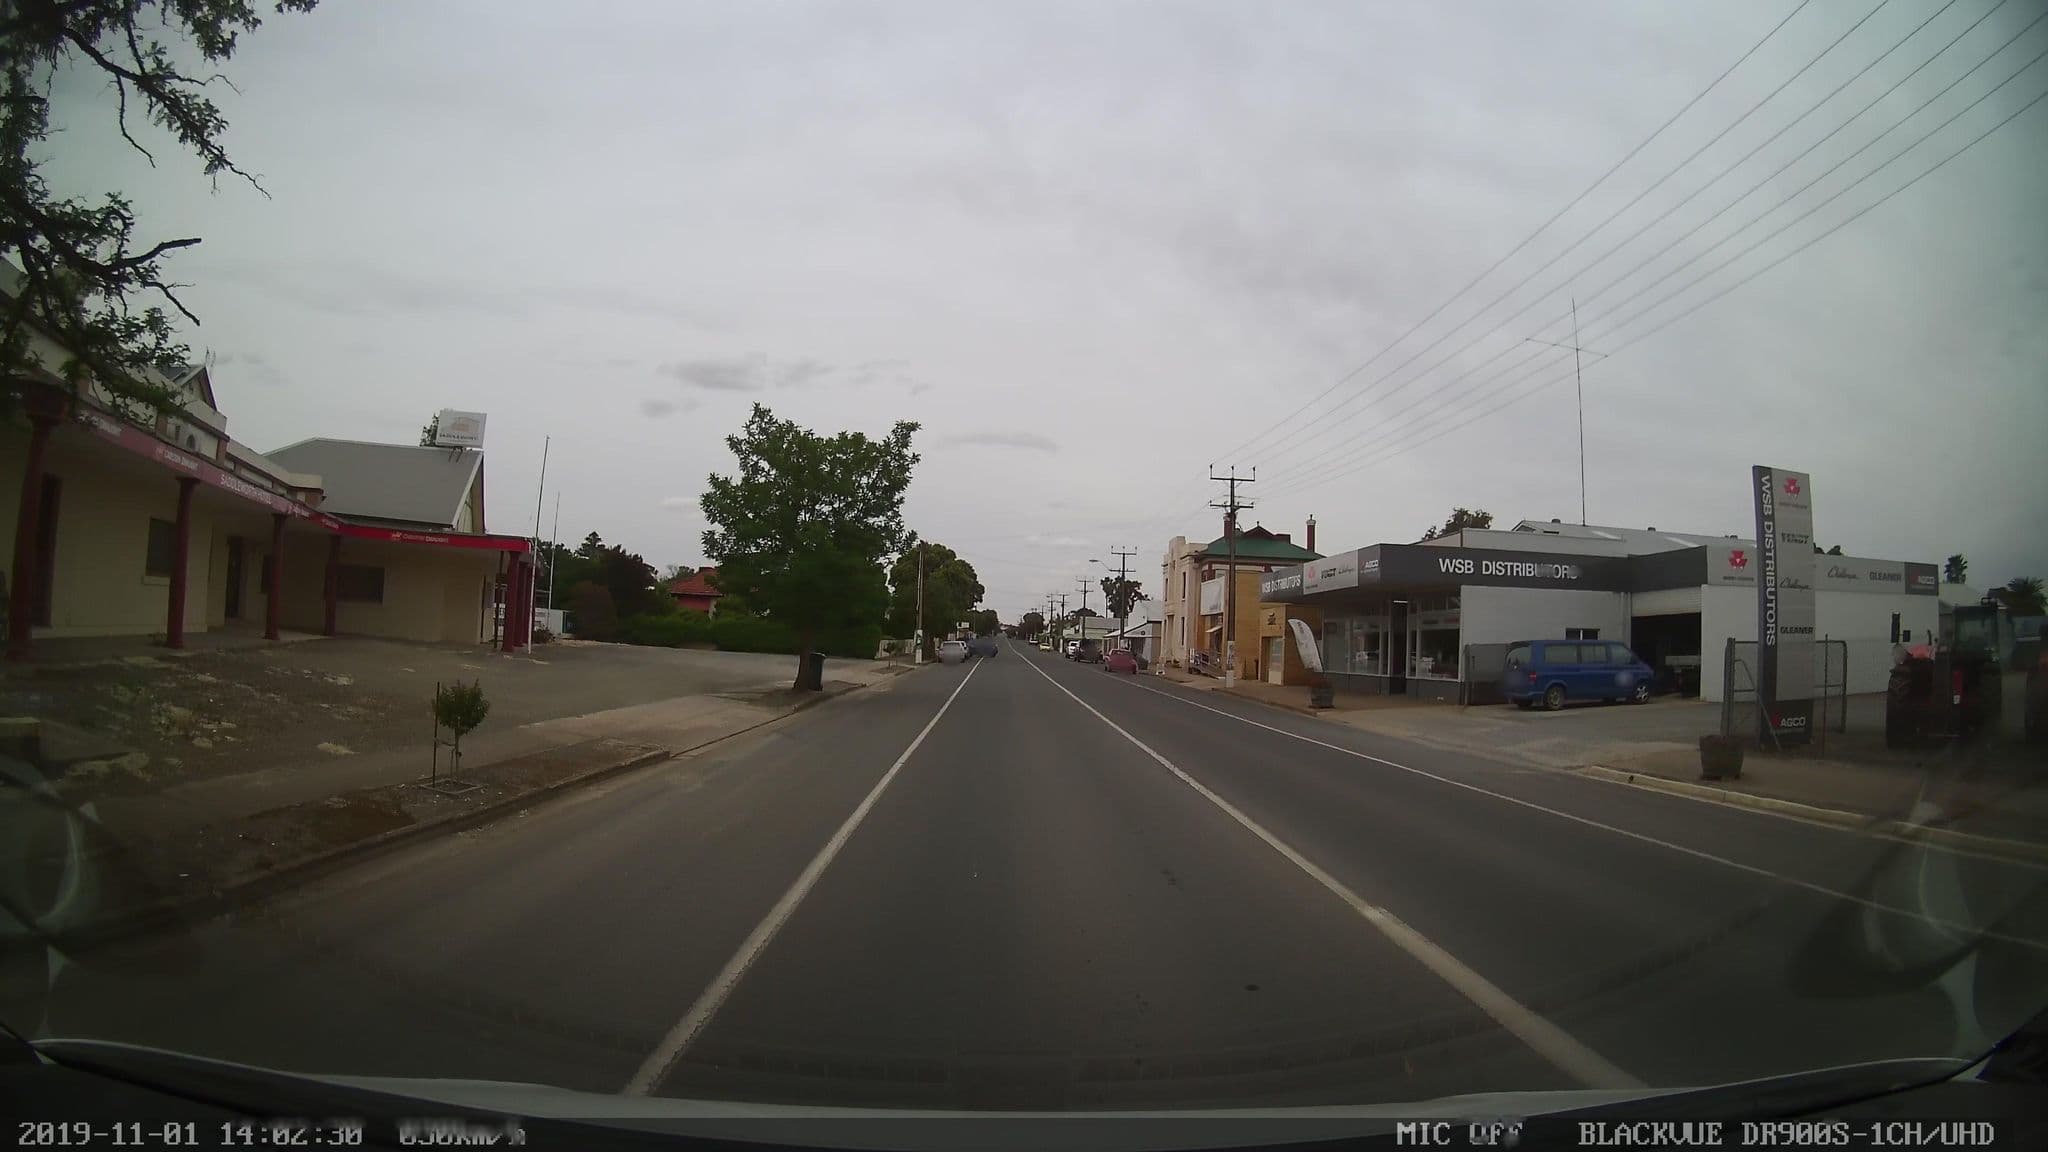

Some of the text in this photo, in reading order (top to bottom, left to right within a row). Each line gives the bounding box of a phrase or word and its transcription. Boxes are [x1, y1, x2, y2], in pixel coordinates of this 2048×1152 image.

[1438, 558, 1474, 574] WSB
[1762, 474, 1776, 646] WSB DISTRIBUTORS
[1780, 625, 1813, 636] GLEANER
[1781, 716, 1806, 728] AGCO
